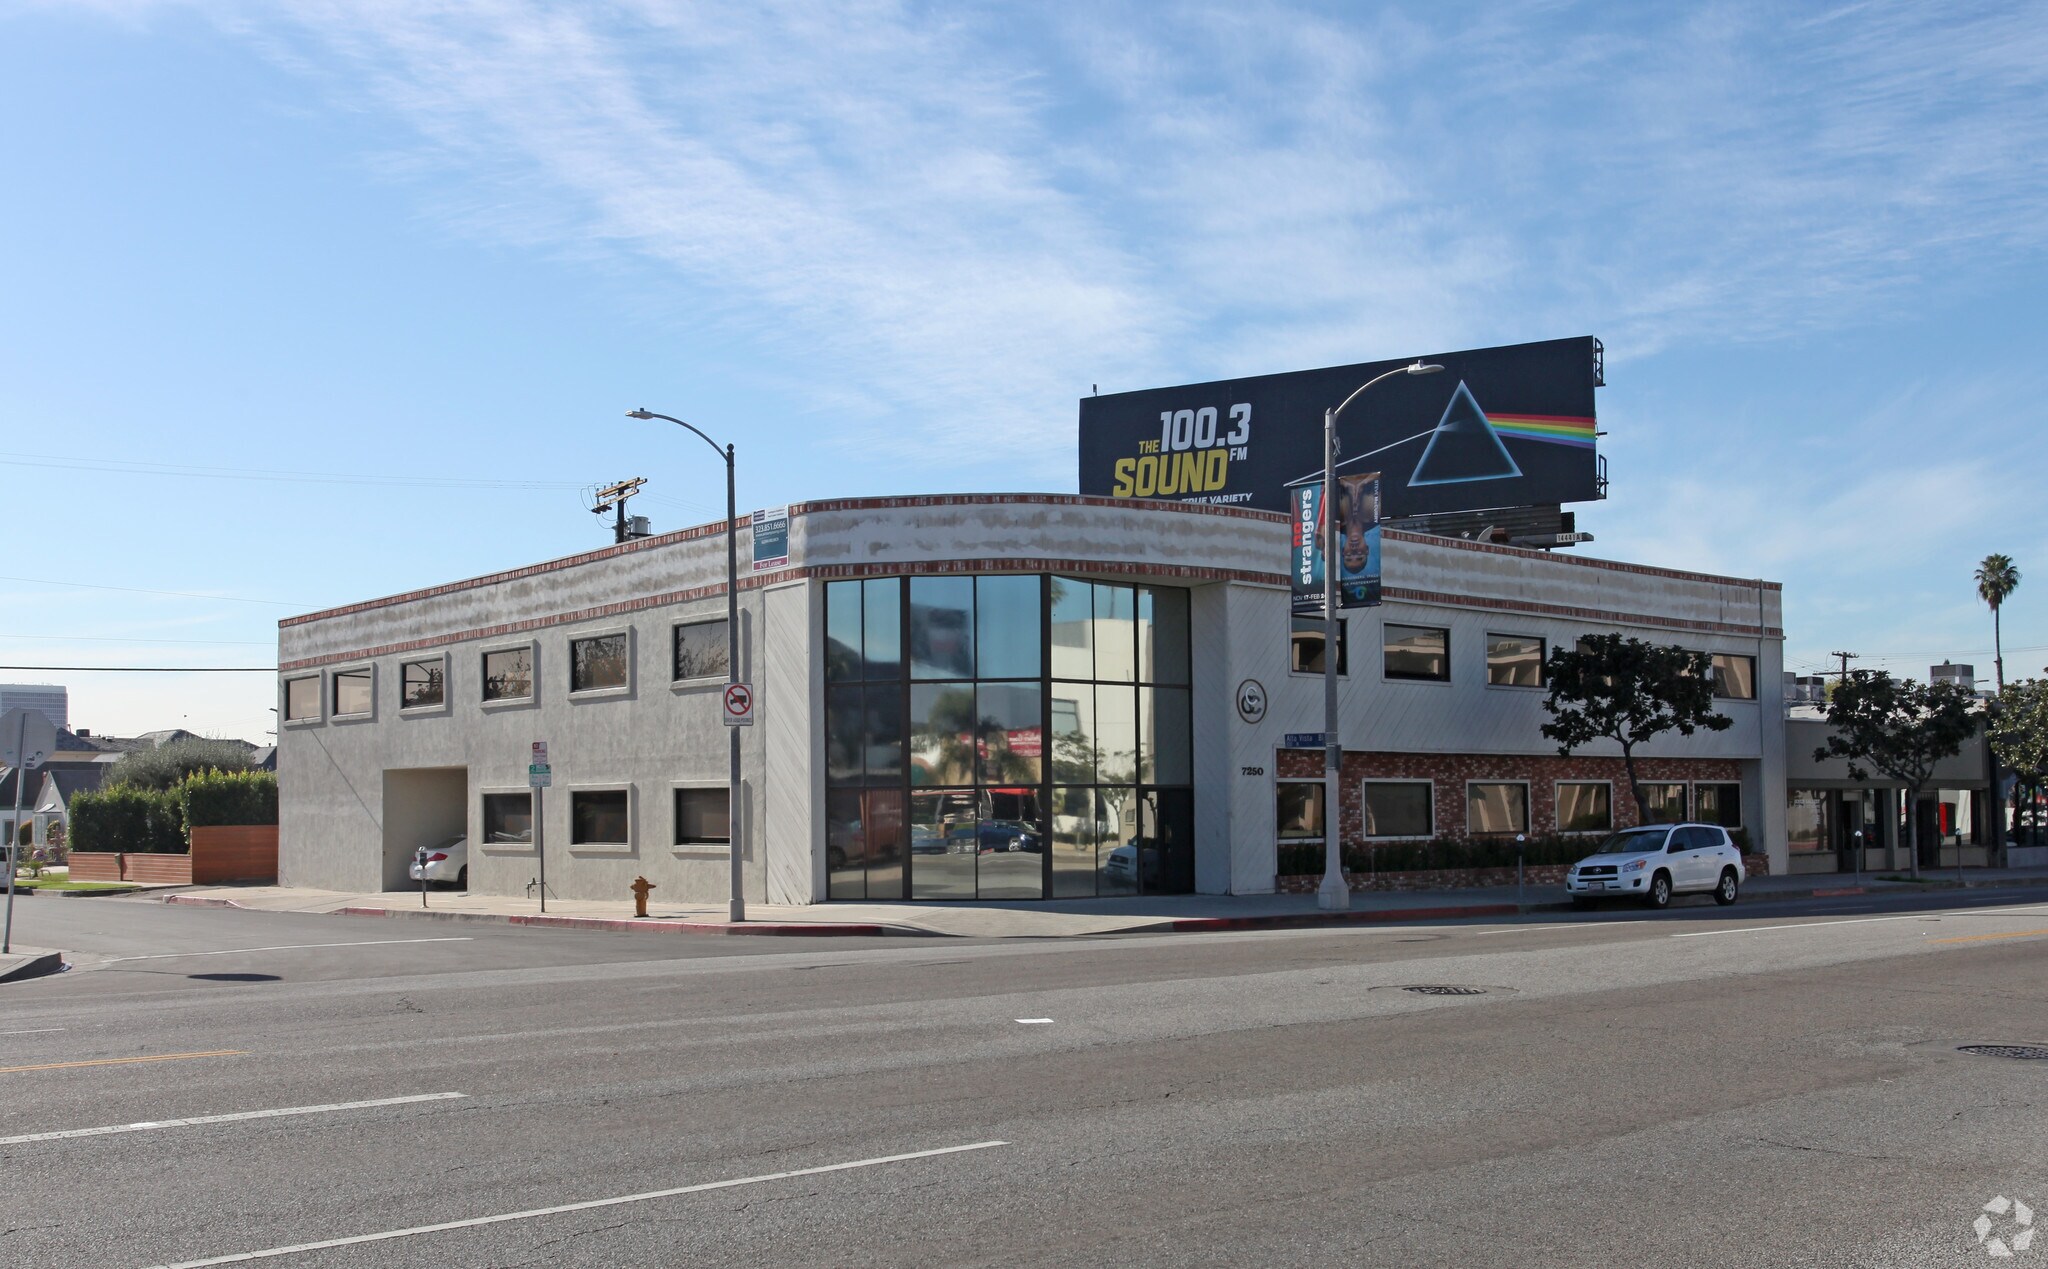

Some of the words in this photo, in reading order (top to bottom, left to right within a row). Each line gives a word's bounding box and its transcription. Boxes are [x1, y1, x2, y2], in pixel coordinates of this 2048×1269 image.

[1139, 440, 1160, 454] THE
[1161, 403, 1252, 452] 100.3
[1113, 449, 1228, 497] SOUND
[1229, 446, 1247, 461] FM
[1209, 493, 1253, 504] VARIETY
[755, 521, 786, 533] 323.851.6666
[1293, 522, 1302, 547] no
[1300, 489, 1314, 585] strangers
[1242, 767, 1264, 776] 7250
